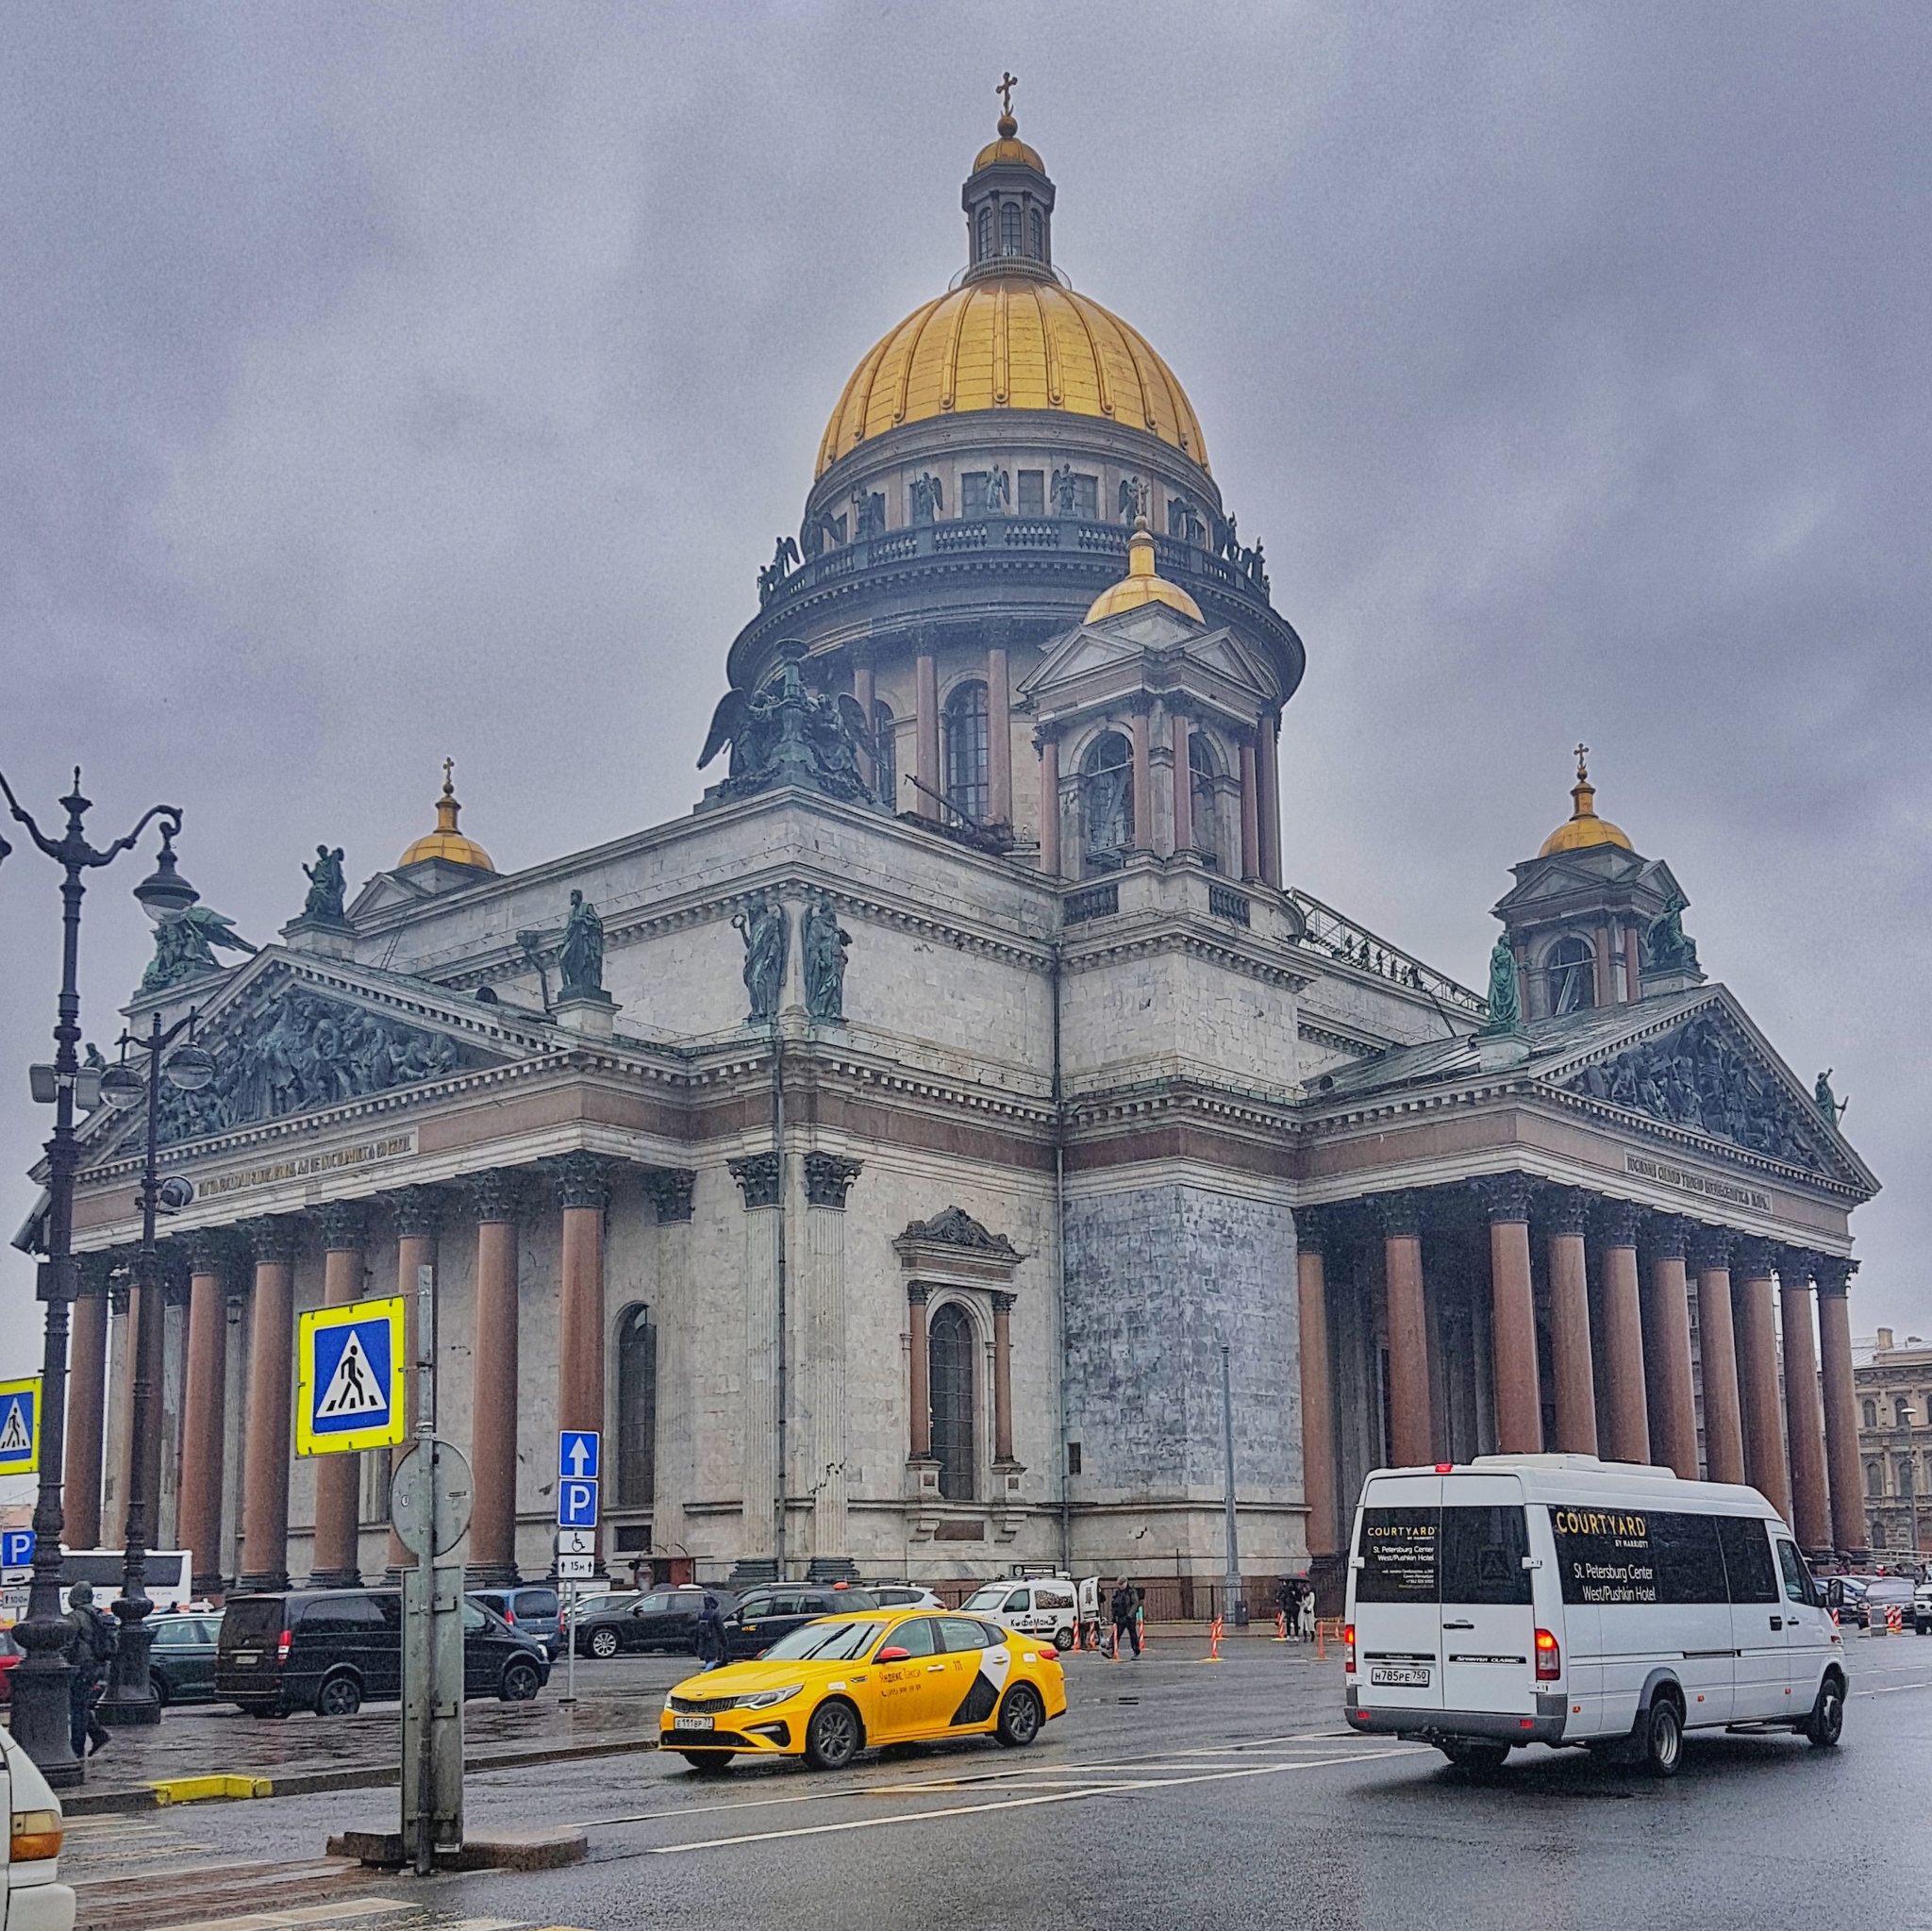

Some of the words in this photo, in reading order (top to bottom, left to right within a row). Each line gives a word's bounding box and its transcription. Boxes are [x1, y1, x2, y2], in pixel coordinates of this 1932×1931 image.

[569, 1485, 591, 1522] P
[1367, 1526, 1435, 1536] COURTYARD
[1557, 1511, 1646, 1537] COURTYARD
[10, 1534, 30, 1563] P
[1381, 1546, 1413, 1555] Petersburg
[1615, 1539, 1622, 1547] BY
[1623, 1540, 1649, 1548] MARRIOTT
[1574, 1562, 1585, 1579] St.
[1585, 1562, 1627, 1583] Petersburg
[1627, 1564, 1653, 1579] Center
[1582, 1586, 1635, 1602] West/Pushkin
[1635, 1586, 1657, 1601] Hotel
